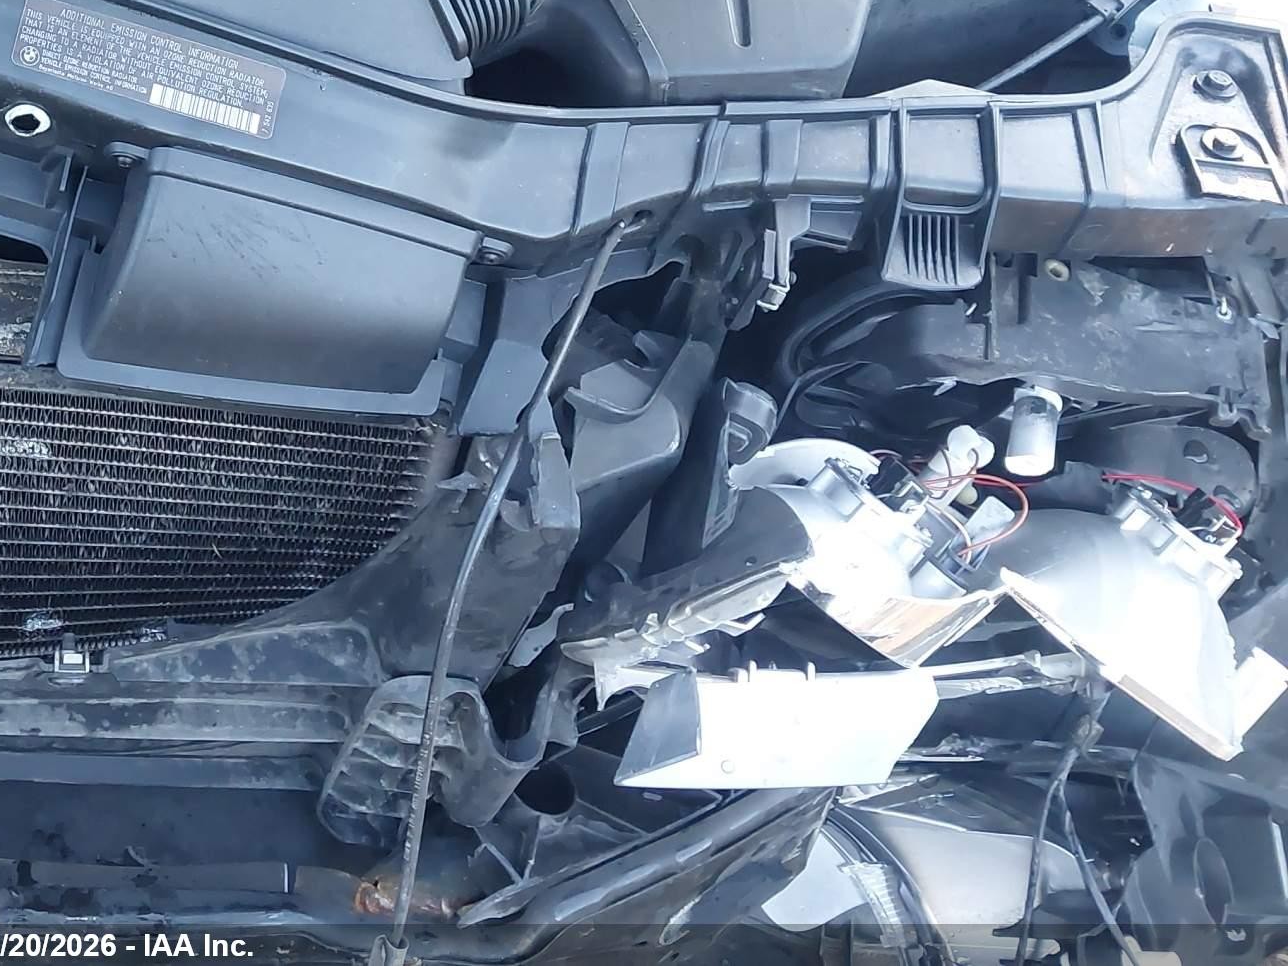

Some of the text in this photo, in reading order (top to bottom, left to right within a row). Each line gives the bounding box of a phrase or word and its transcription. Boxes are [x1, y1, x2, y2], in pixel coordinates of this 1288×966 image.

[18, 33, 62, 52] PROPERTIES
[65, 47, 73, 55] IS
[86, 53, 125, 71] VIOLATION
[127, 66, 136, 74] OF
[140, 70, 154, 79] AIR
[156, 74, 195, 92] POLLUTION
[21, 25, 57, 42] CHANGING
[60, 36, 69, 46] TO
[81, 43, 117, 60] RADIATOR
[120, 54, 152, 70] WITHOUT
[154, 65, 198, 84] EQUIVALENT
[200, 79, 224, 93] OZONE
[226, 87, 264, 105] REDUCTION
[23, 16, 42, 28] THAT
[46, 23, 54, 32] IS
[57, 26, 68, 36] AN
[70, 30, 102, 47] ELEMENT
[105, 41, 115, 51] OF
[118, 45, 132, 56] THE
[137, 51, 166, 66] VEHICLE
[168, 60, 203, 77] EMISSION
[204, 71, 236, 87] CONTROL
[25, 8, 265, 87] THIS VEHICLE IS EQUIPPED WITH AN OZONE REDUCTION RADIATOR
[60, 7, 239, 69] ADDITIONAL EMISSION CONTROL INFORMATION
